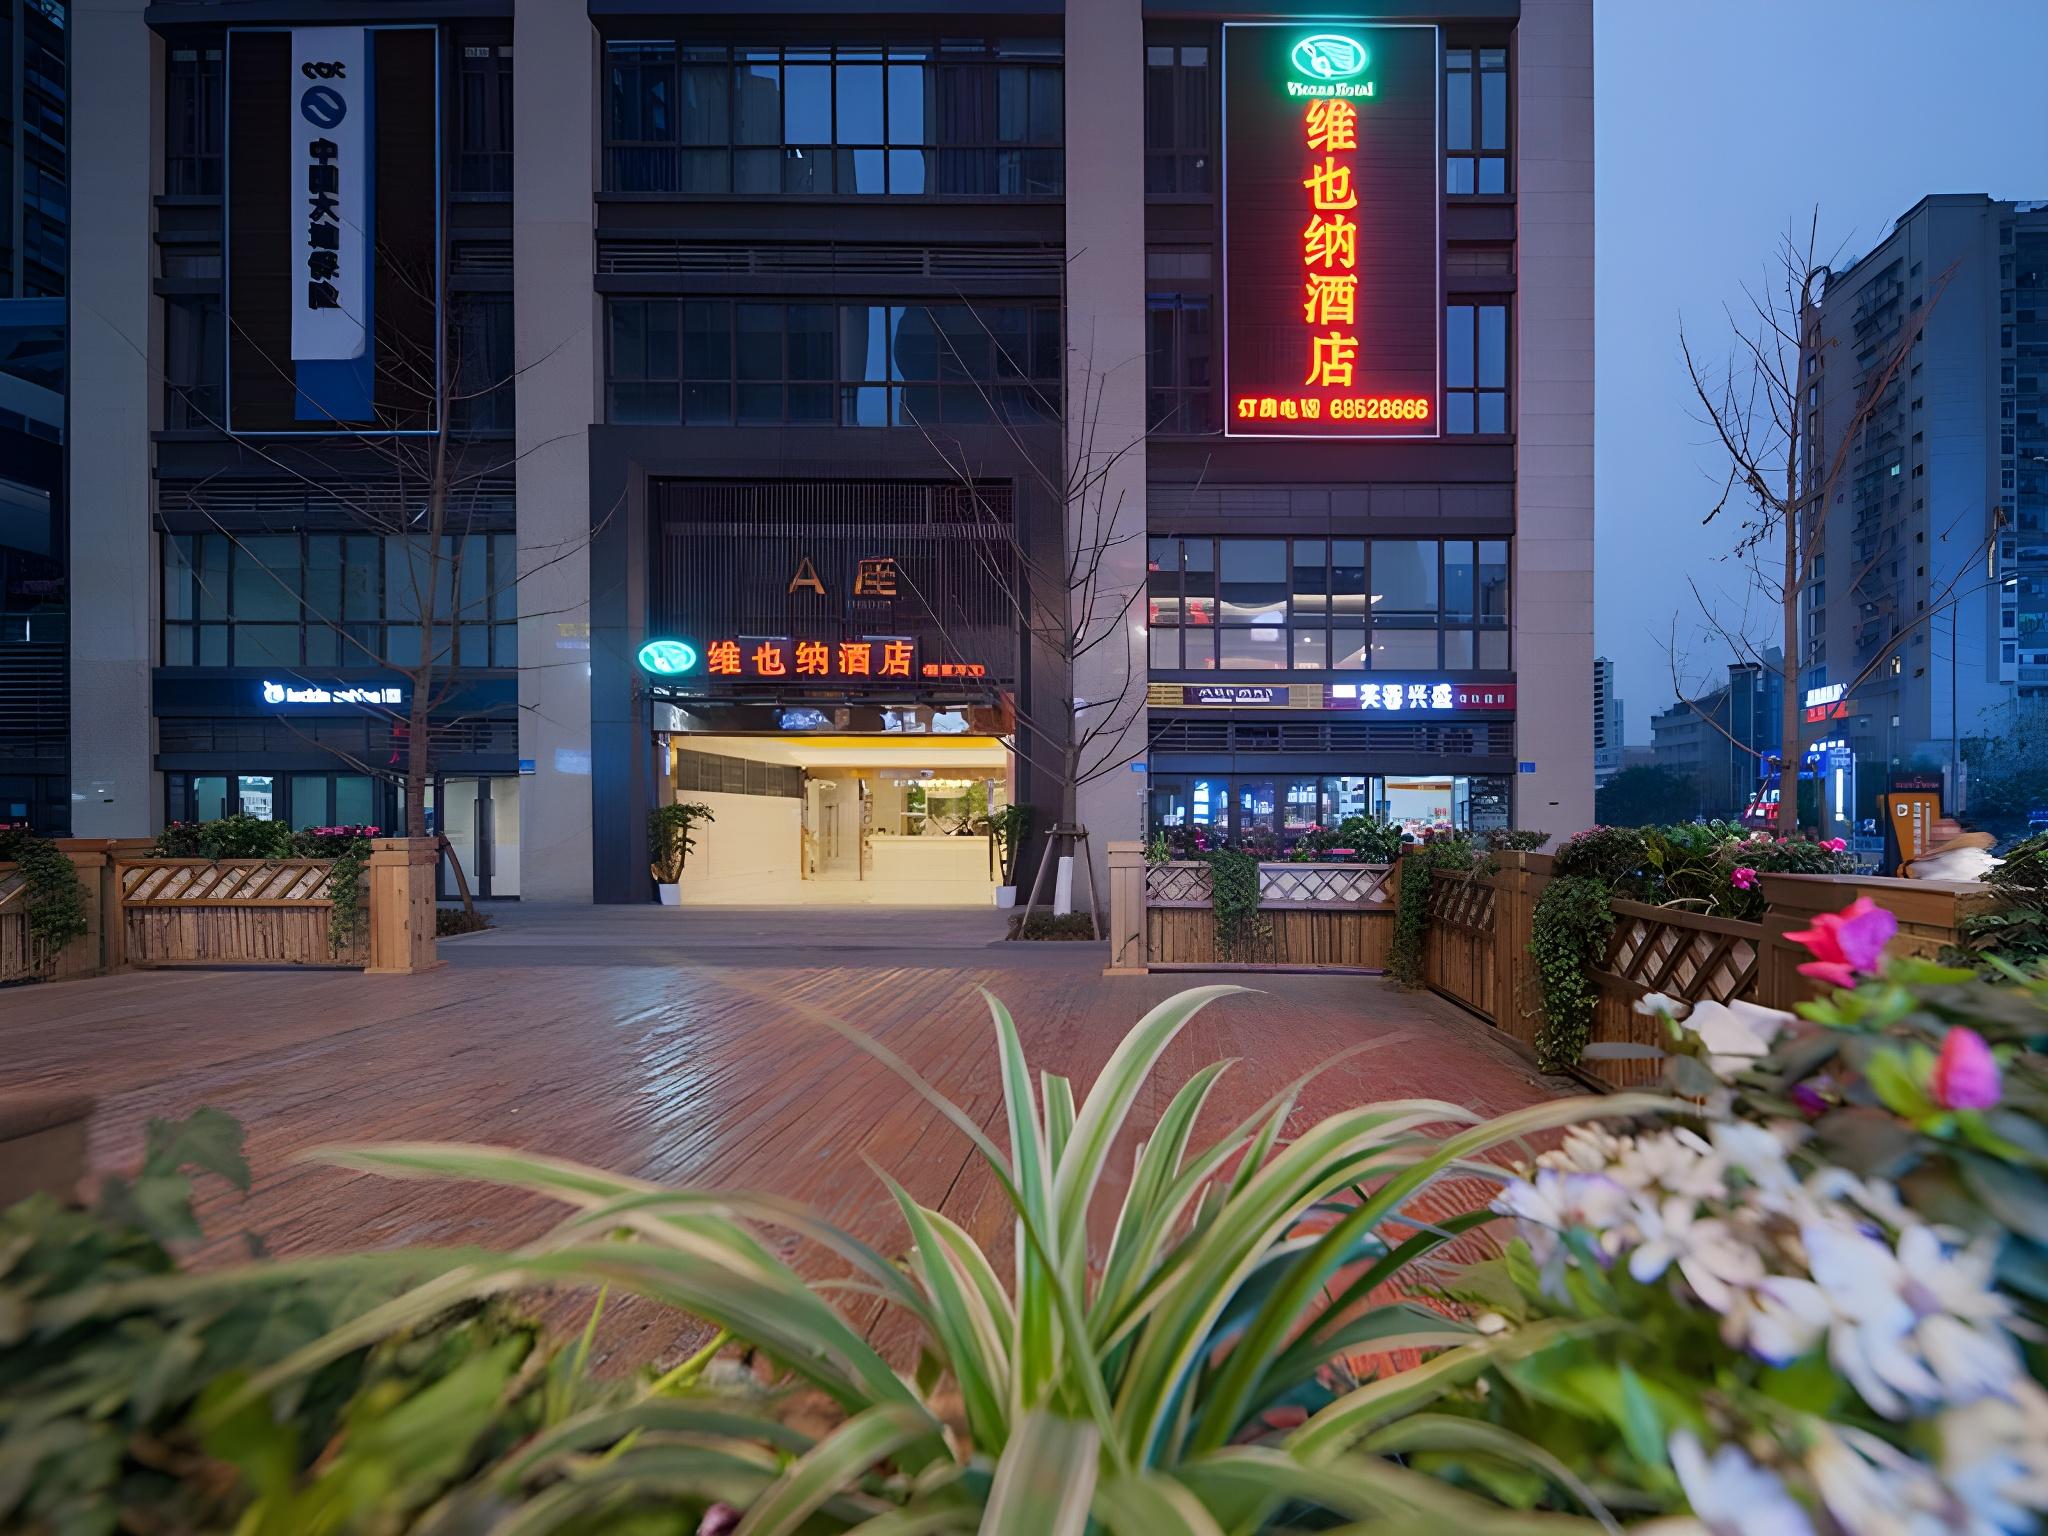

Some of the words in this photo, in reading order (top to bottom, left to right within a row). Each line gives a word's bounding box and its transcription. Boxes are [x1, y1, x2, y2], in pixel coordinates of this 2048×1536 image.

[1304, 99, 1358, 387] 维也纳酒店
[708, 640, 915, 676] 维也纳酒店
